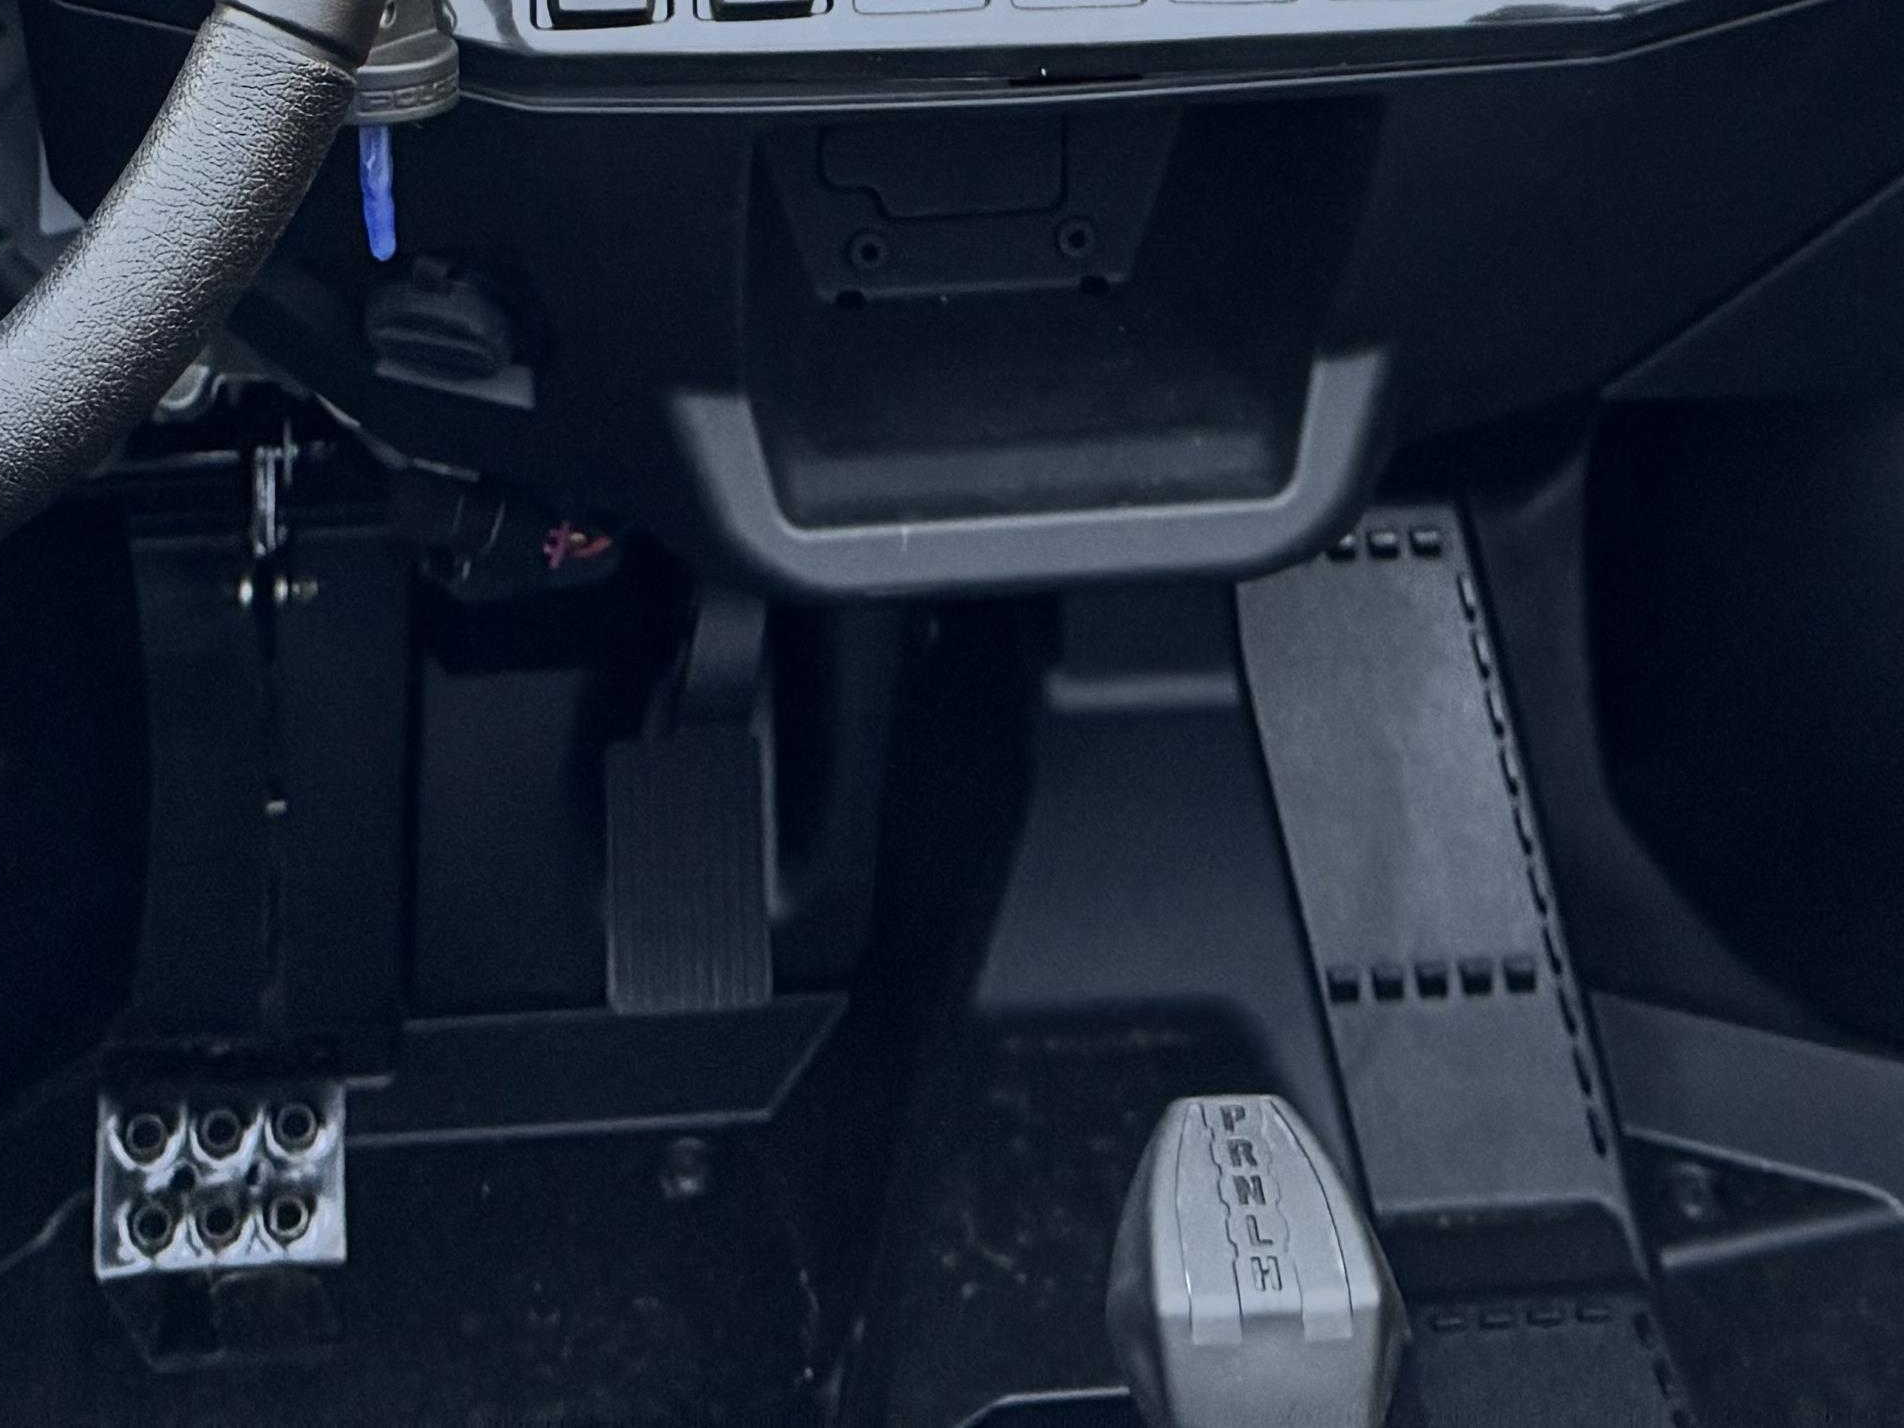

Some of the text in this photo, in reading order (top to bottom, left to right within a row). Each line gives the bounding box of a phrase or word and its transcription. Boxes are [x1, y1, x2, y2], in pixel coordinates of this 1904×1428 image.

[1220, 1104, 1246, 1134] P
[1226, 1138, 1258, 1168] R
[1232, 1174, 1267, 1206] N
[1245, 1214, 1274, 1247] L
[1251, 1255, 1284, 1293] H
